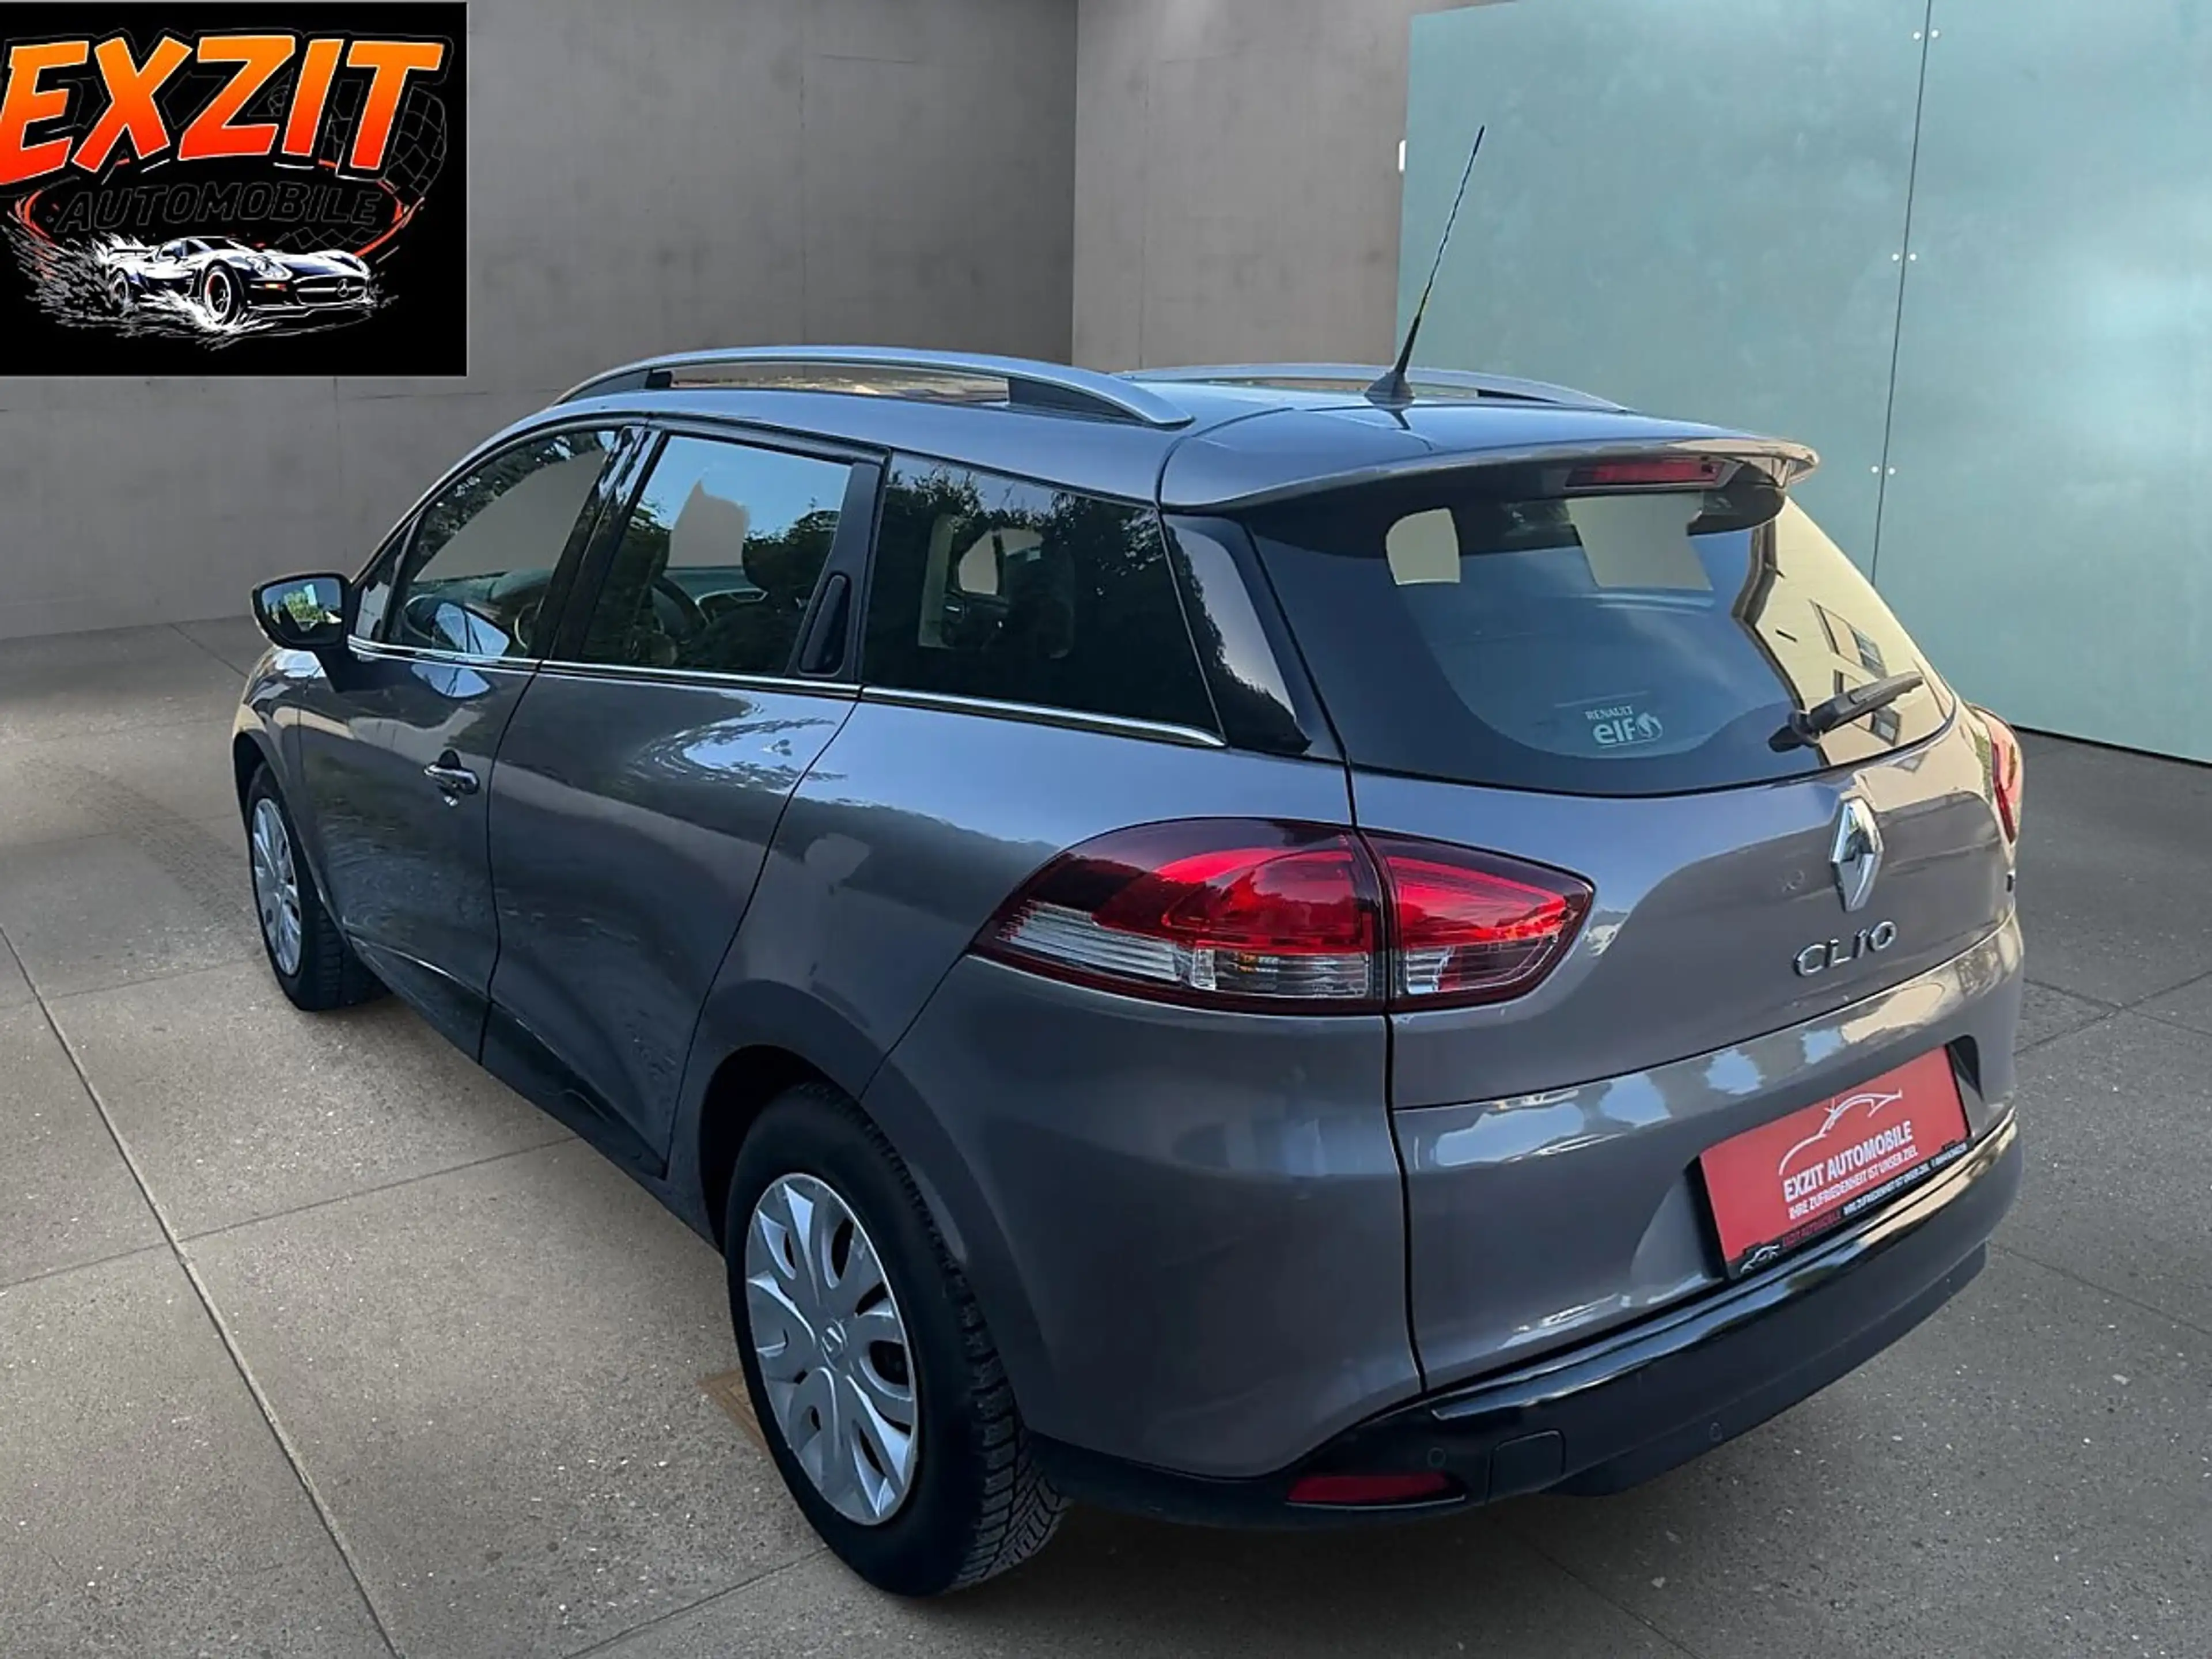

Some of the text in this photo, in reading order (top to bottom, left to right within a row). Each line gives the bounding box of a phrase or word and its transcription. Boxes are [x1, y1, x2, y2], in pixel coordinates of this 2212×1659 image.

[1585, 705, 1634, 721] RENAULT
[1593, 718, 1635, 744] elf
[1794, 920, 1897, 977] CLIO
[1783, 1163, 1824, 1202] EXZIT
[1827, 1120, 1913, 1180] AUTOMOBILE
